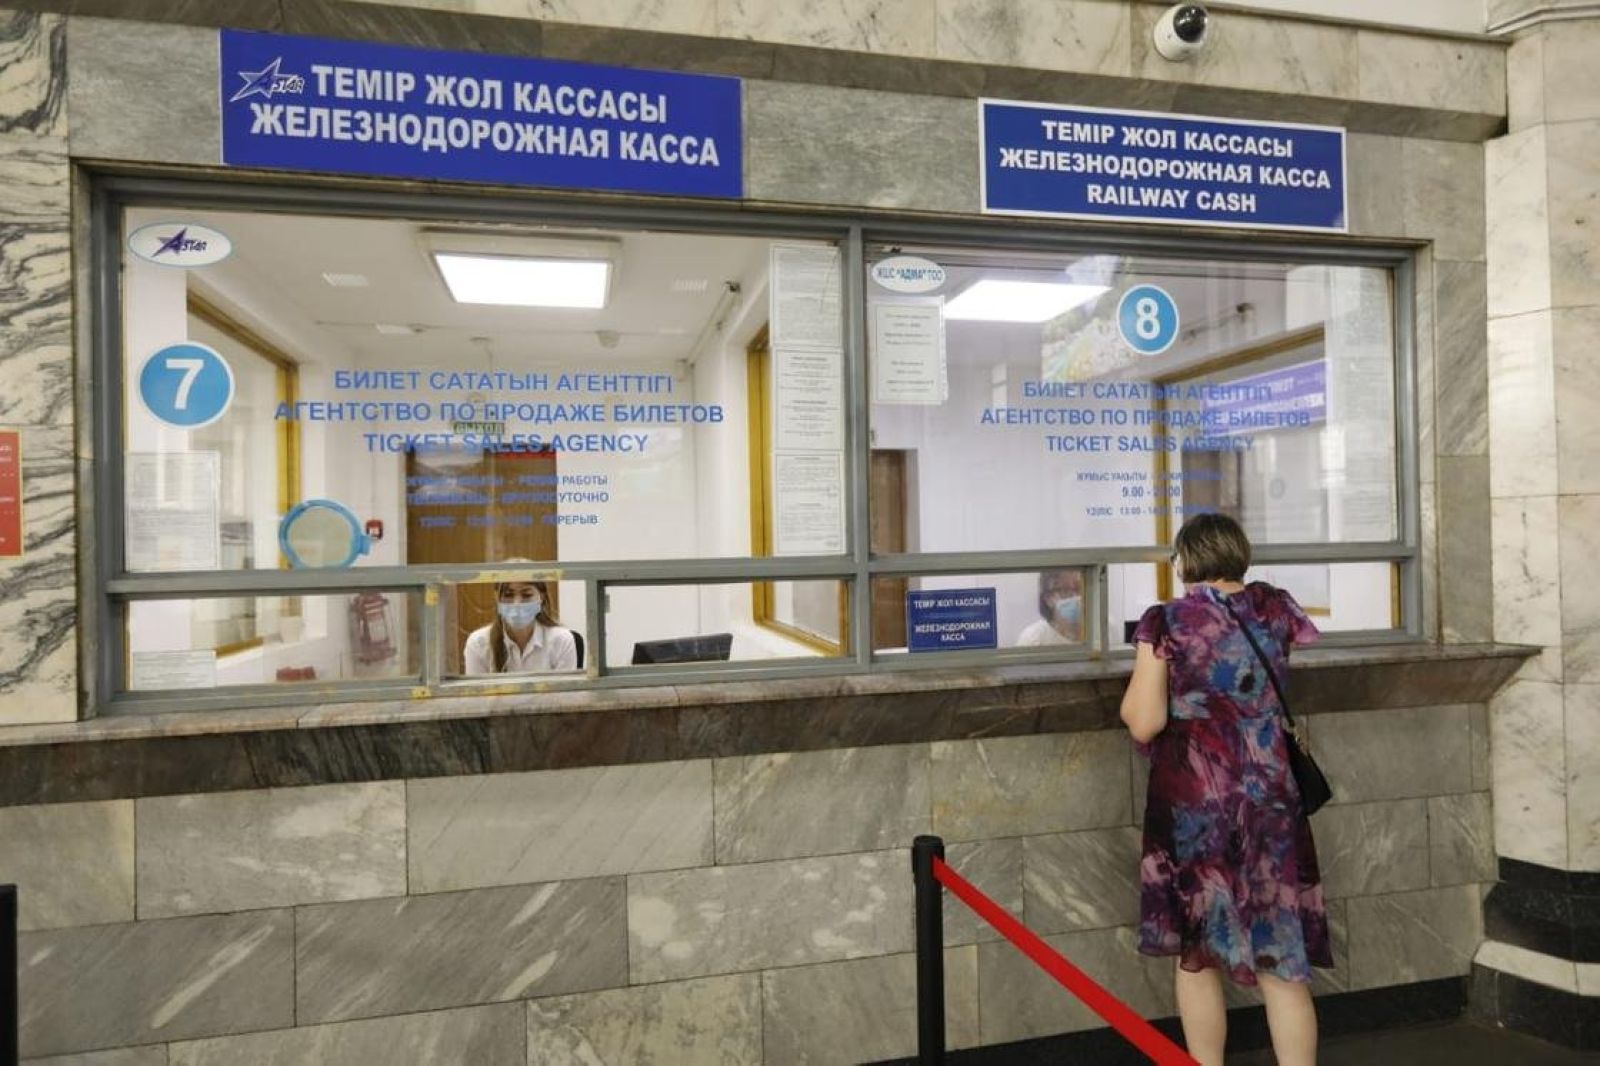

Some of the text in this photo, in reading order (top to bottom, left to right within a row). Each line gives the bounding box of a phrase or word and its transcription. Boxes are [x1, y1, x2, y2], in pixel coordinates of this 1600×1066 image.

[311, 65, 667, 124] ТЕМІР ЖОЛ КАССАСЫ
[250, 103, 720, 167] ЖЕЛЕЗНОДОРОЖНАЯ КАССА
[1041, 120, 1293, 158] ТЕМІР ЖОЛ КАССАСЫ
[999, 148, 1331, 189] ЖЕЛЕЗНОДОРОЖНАЯ КАССА
[1087, 184, 1257, 213] RAILWAY CASH
[1135, 297, 1161, 340] 8
[165, 359, 205, 410] 7
[335, 370, 672, 393] БИЛЕТ САТАТЫН АГЕНТТІГІ
[1024, 380, 1088, 398] БИЛЕТ
[1093, 381, 1180, 399] САТАТЫН
[274, 401, 724, 425] АГЕНТСТВО ПО ПРОДАЖЕ БИЛЕТОВ
[981, 409, 1311, 428] АГЕНТСТВО ПО ПРОДАЖЕ БИЛЕТОВ
[363, 433, 648, 454] TICKET SALES AGENCY
[1046, 435, 1255, 452] TICKET SALES AGENCY
[562, 475, 608, 486] РАБОТЫ
